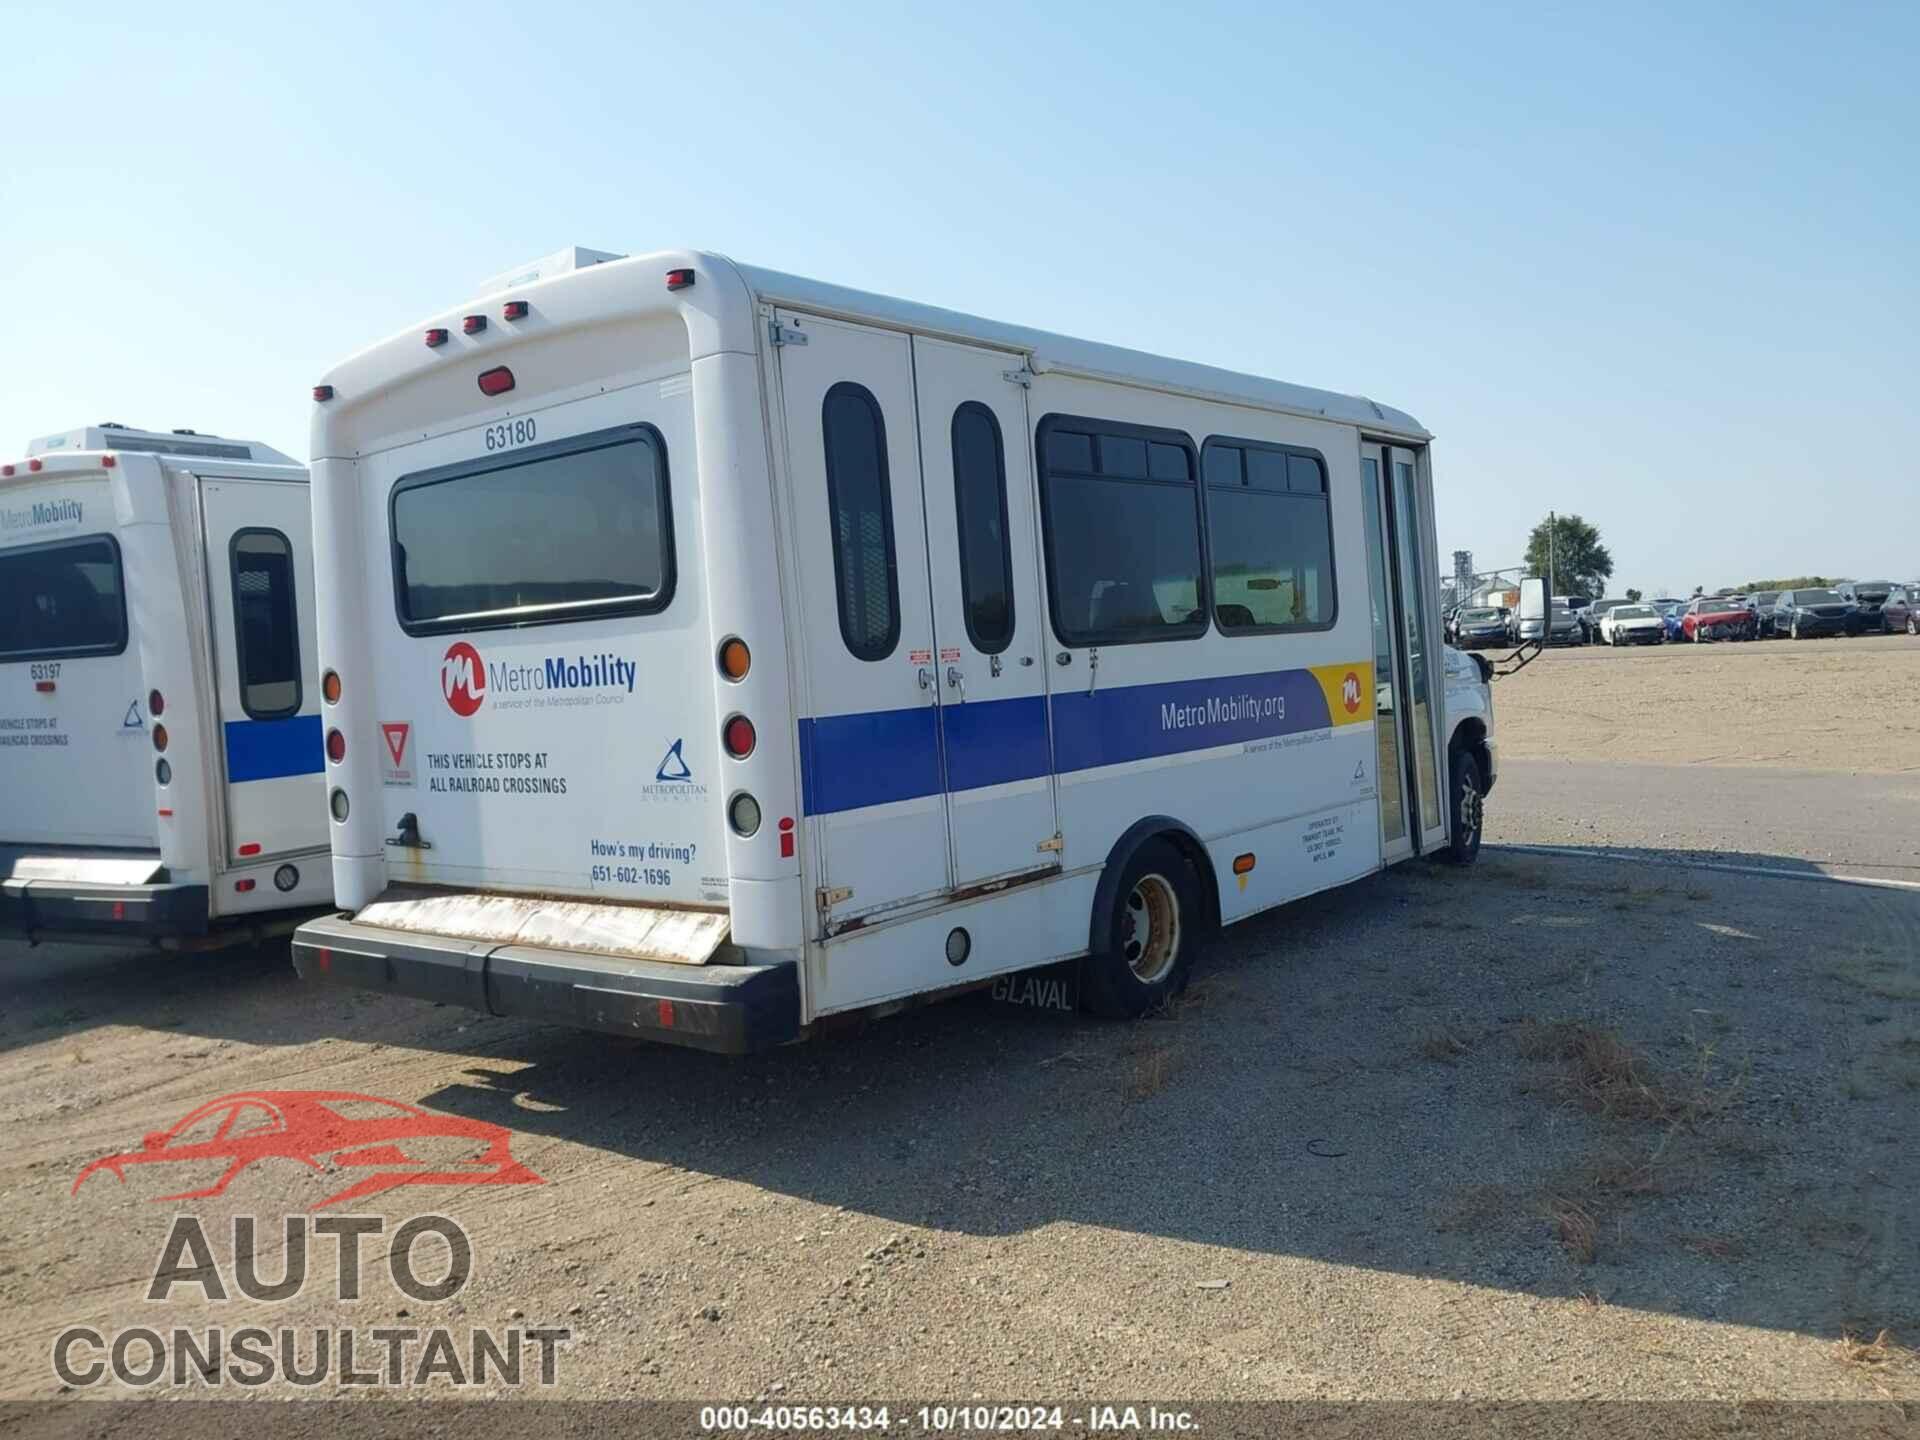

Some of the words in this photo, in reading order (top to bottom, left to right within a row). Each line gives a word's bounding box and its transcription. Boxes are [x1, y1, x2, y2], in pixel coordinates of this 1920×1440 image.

[485, 418, 537, 450] 63180
[31, 663, 61, 680] 63197
[489, 653, 636, 693] MetroMobility
[1161, 695, 1285, 731] MetroMobility.org
[427, 754, 450, 769] THIS
[452, 753, 494, 769] VEHICLE
[496, 753, 532, 769] STOPS
[535, 752, 548, 769] AT
[430, 776, 448, 792] ALL
[449, 776, 500, 793] RAILROAD
[503, 777, 567, 794] CROSSINGS
[591, 839, 626, 857] How's
[628, 844, 646, 861] my
[648, 842, 697, 865] driving?
[592, 865, 671, 885] 651-602-1696
[992, 975, 1073, 1011] GLAVAL
